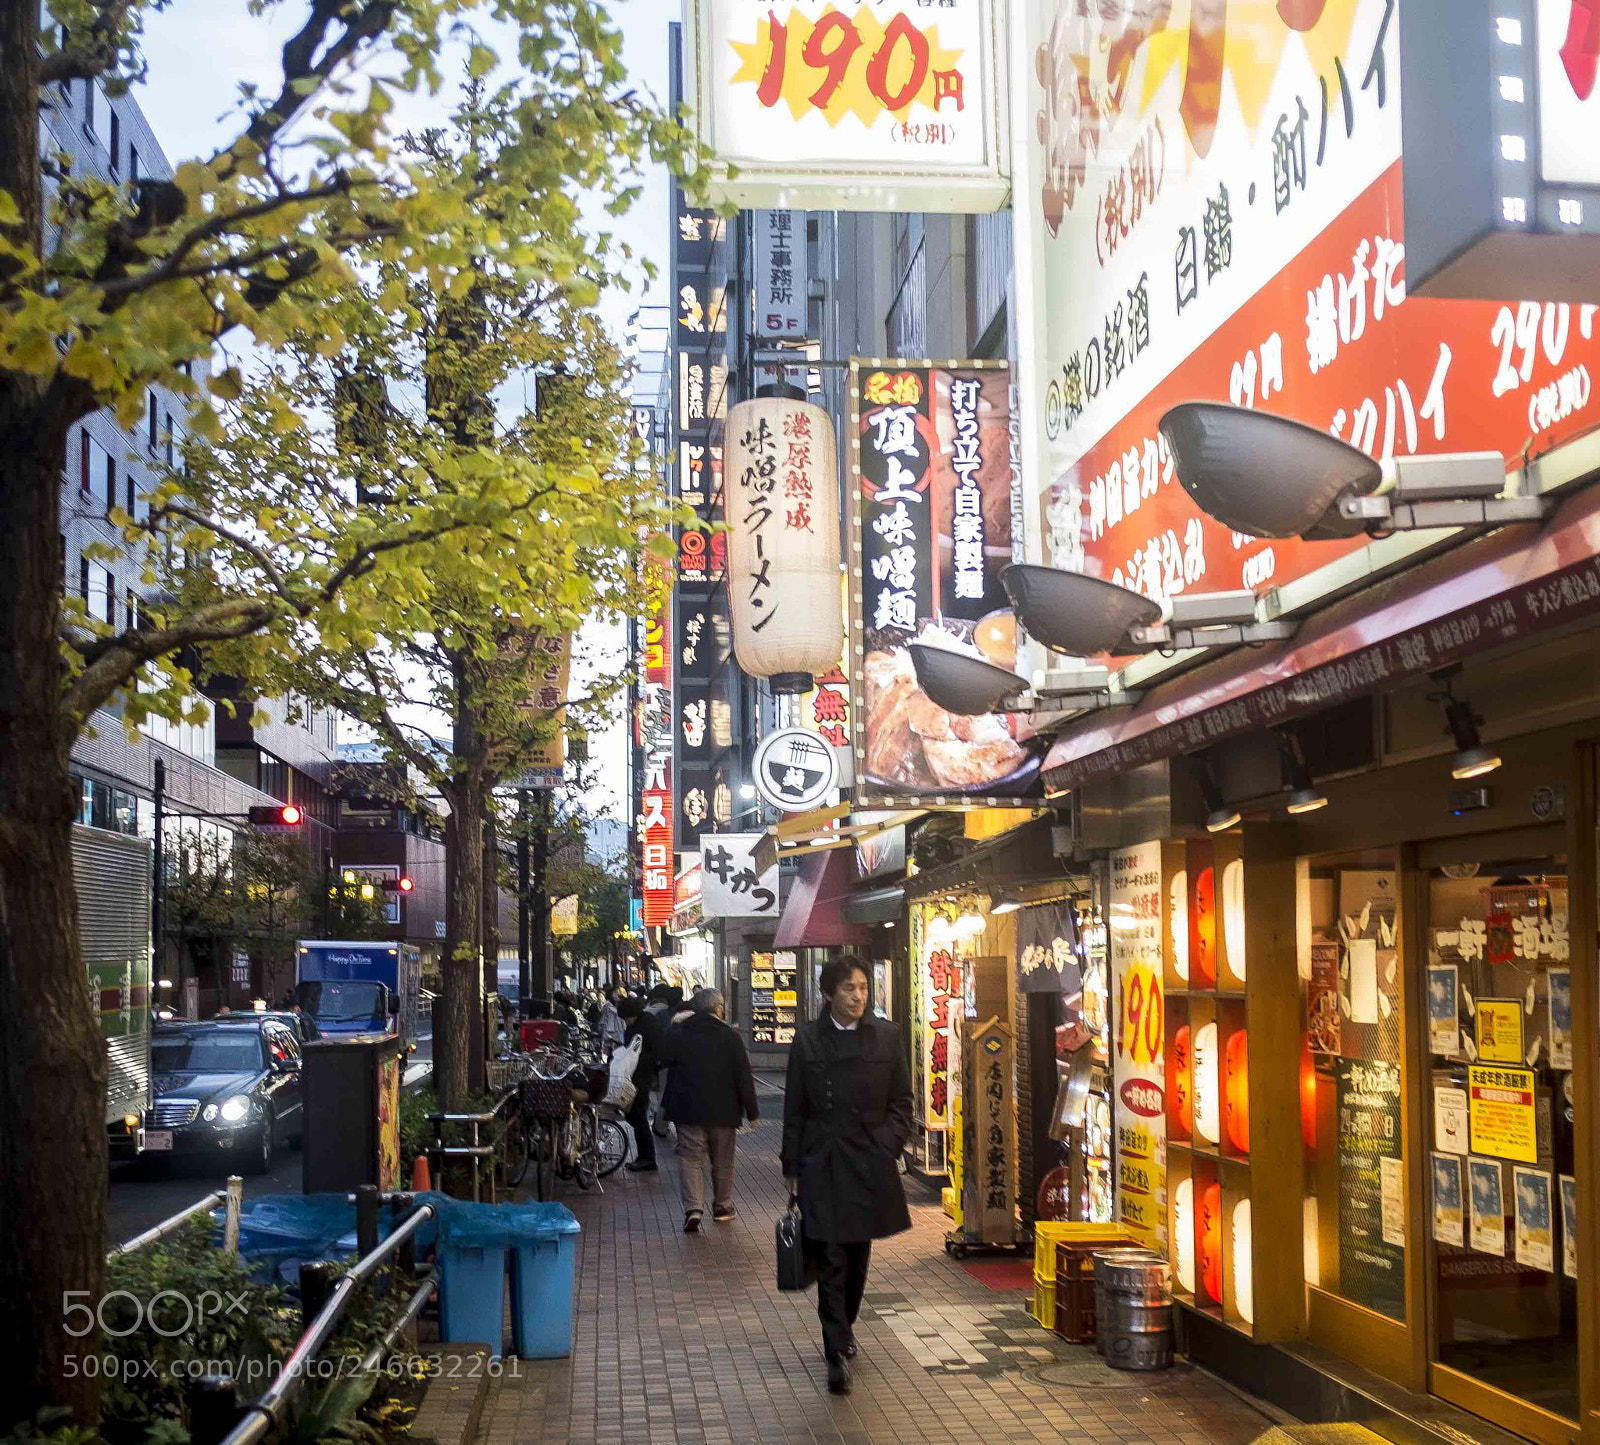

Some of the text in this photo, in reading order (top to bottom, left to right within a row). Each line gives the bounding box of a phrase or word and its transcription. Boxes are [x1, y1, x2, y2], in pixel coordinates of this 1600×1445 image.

[755, 10, 965, 112] 190円
[769, 209, 793, 305] 理士事務所
[766, 313, 799, 332] 5F
[740, 417, 780, 634] 味噌ラーメン
[951, 379, 985, 600] 打ち立て自家製麺
[704, 844, 776, 912] 牛かつ
